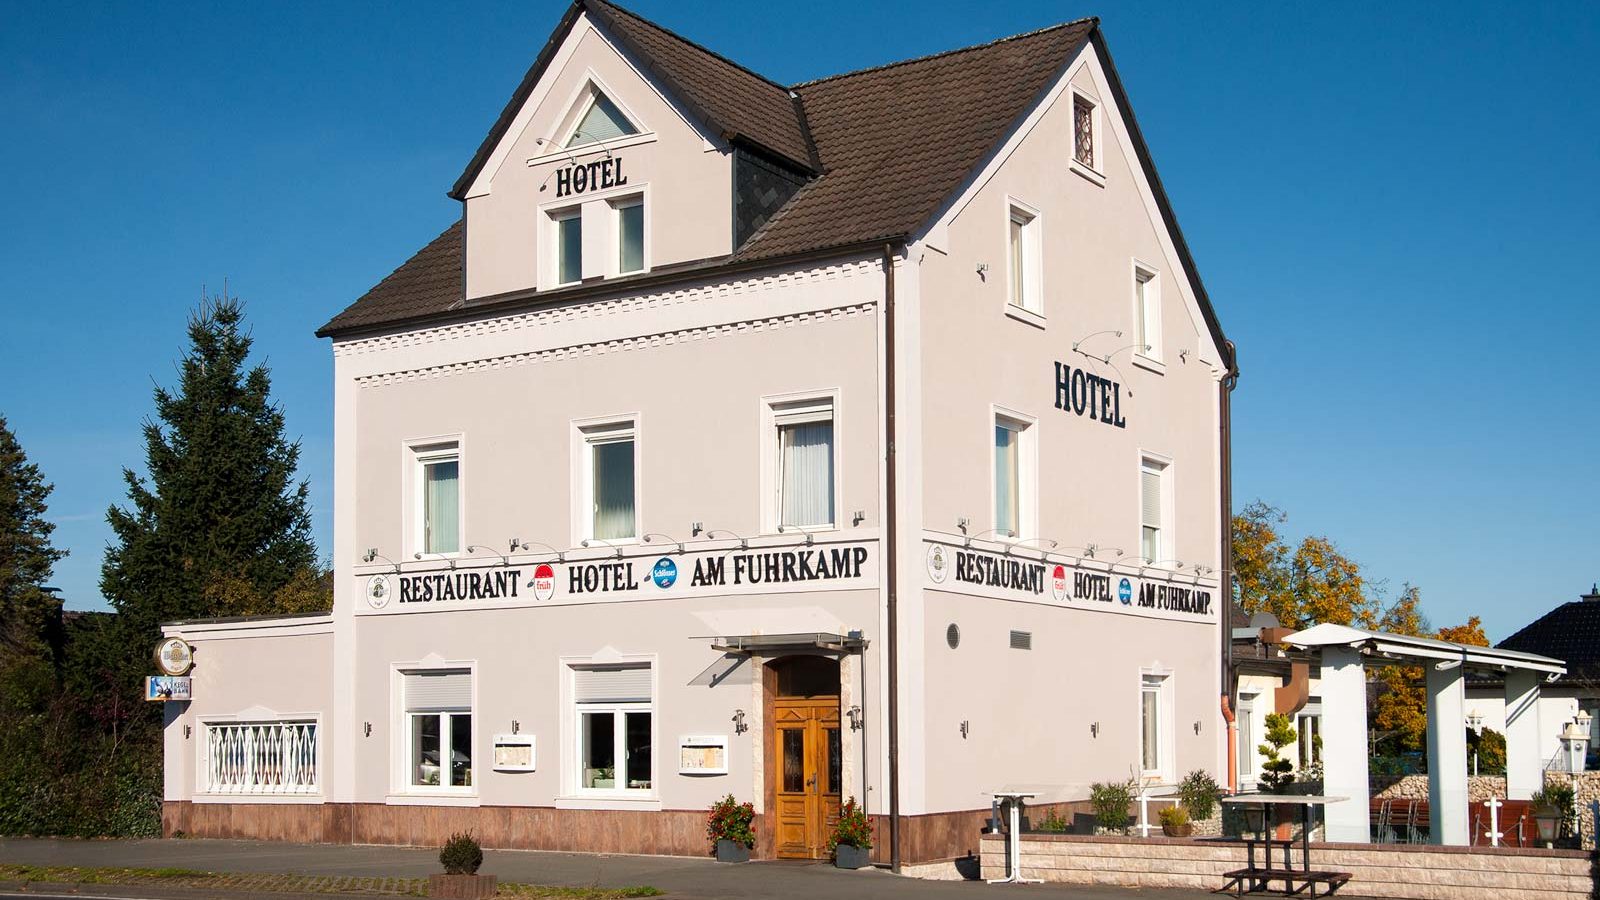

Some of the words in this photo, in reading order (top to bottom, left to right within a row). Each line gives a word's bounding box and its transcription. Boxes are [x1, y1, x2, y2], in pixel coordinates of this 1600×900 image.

[556, 157, 628, 198] HOTEL
[1054, 360, 1126, 429] HOTEL
[399, 570, 521, 603] RESTAURANT
[568, 563, 639, 594] HOTEL
[690, 556, 726, 587] AM
[733, 547, 868, 585] FUHRKAMP
[955, 551, 1046, 595] RESTAURANT
[1073, 571, 1113, 602] HOTEL
[1137, 582, 1156, 609] AM
[1158, 585, 1211, 615] FUHRKAMP
